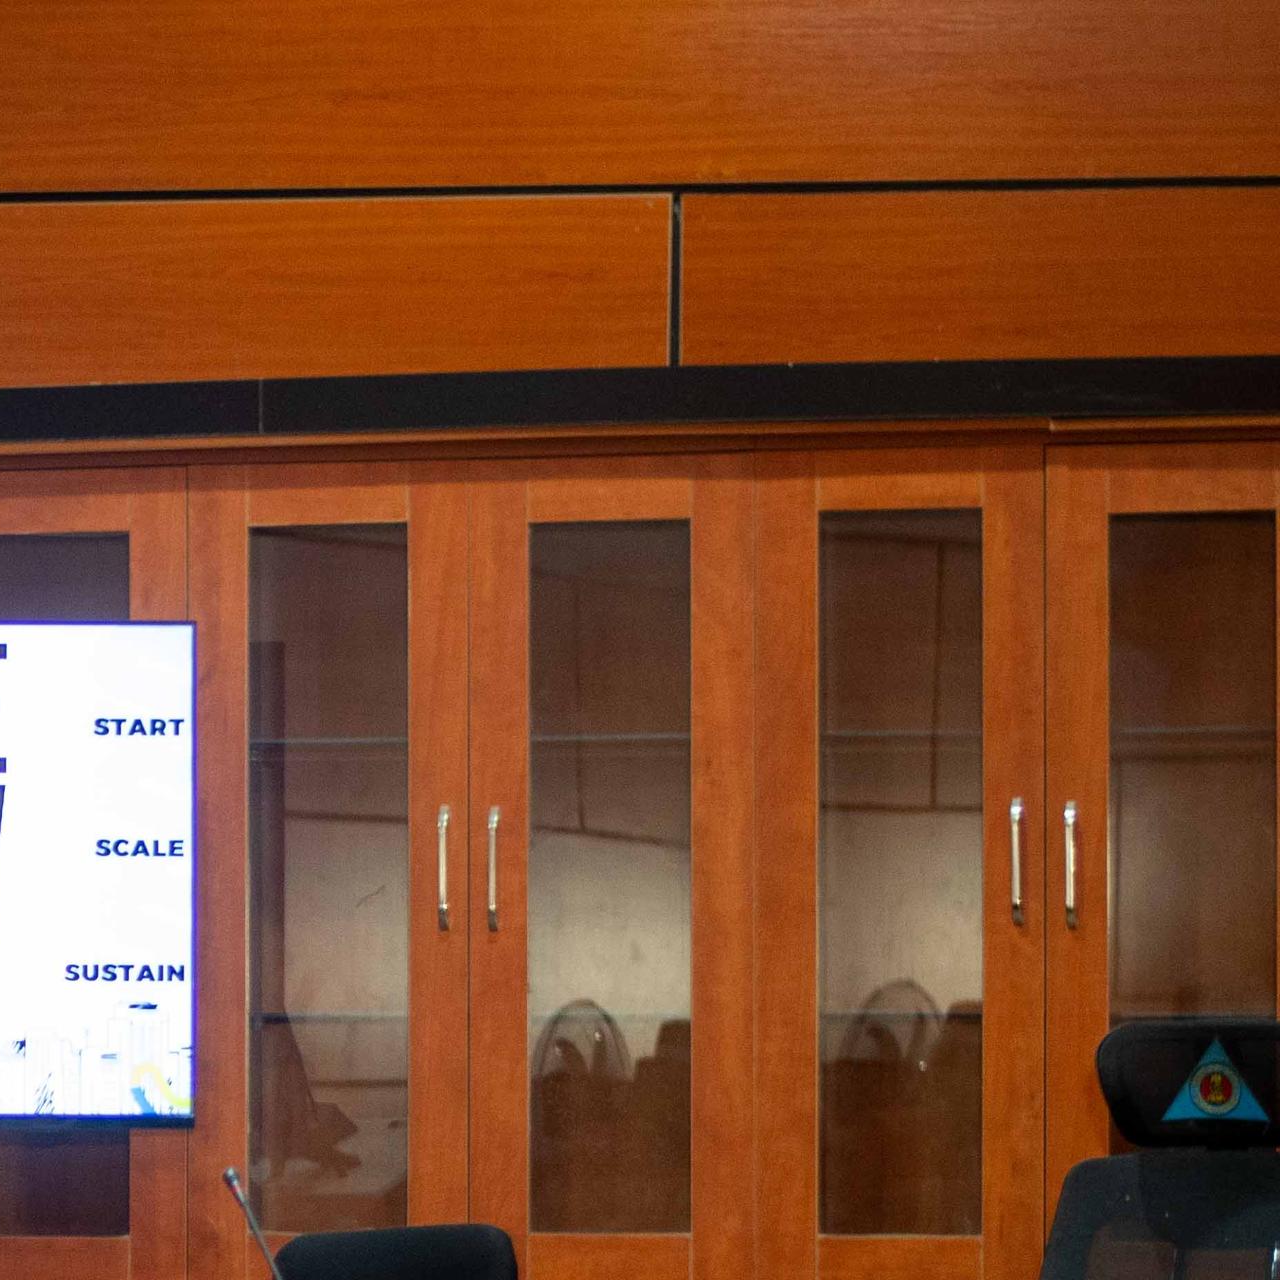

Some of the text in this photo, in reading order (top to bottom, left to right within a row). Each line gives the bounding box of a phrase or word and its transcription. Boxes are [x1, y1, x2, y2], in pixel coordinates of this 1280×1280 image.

[94, 718, 184, 736] START
[96, 839, 184, 857] SCALE
[64, 964, 185, 982] SUSTAIN
